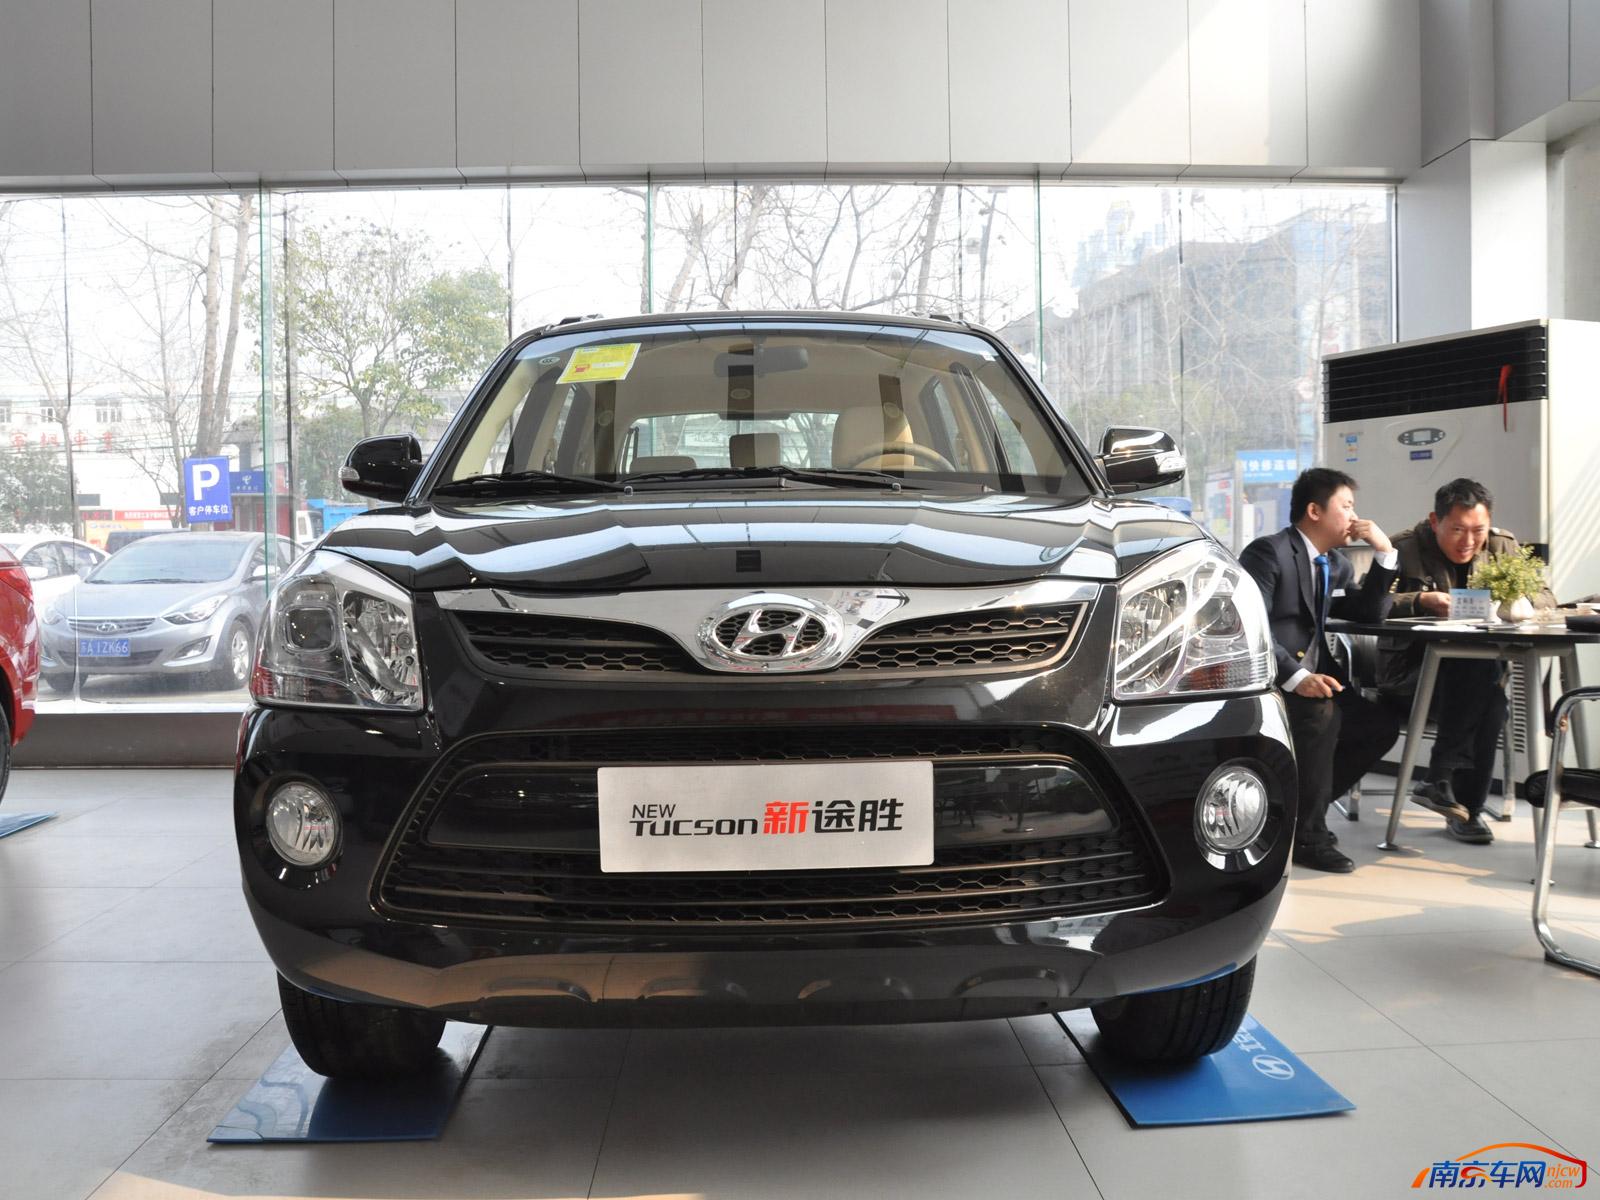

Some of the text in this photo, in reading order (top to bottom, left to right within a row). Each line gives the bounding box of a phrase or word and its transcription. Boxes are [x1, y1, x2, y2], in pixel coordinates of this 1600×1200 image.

[192, 463, 220, 501] P
[188, 503, 229, 517] 客户停车位
[632, 803, 676, 819] NEW
[762, 798, 904, 835] 新途胜
